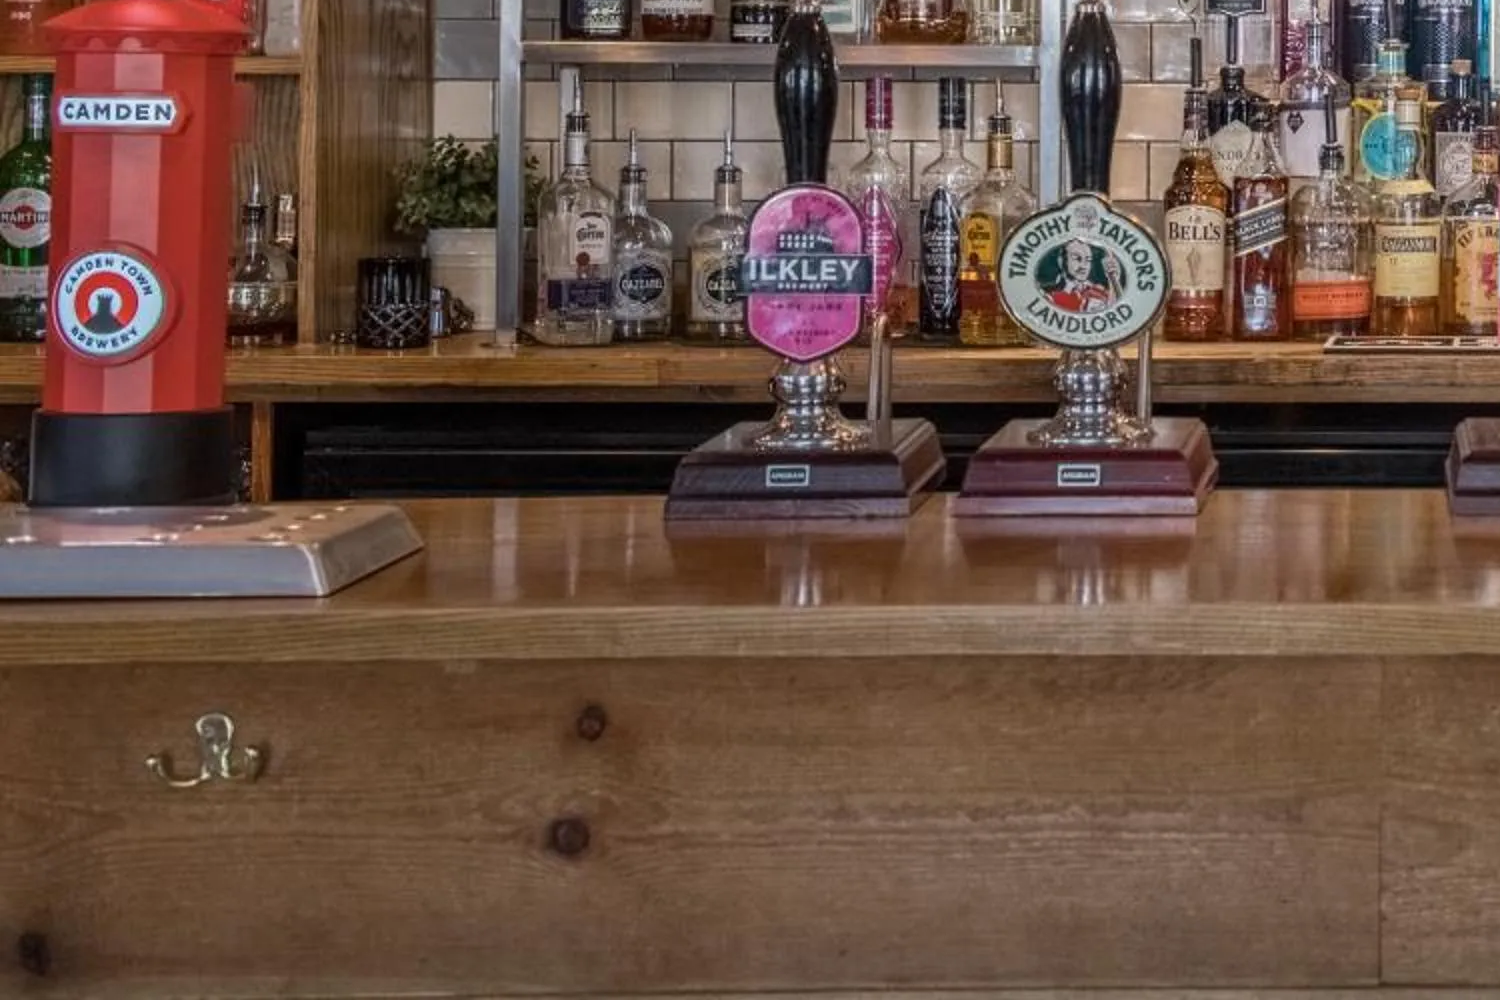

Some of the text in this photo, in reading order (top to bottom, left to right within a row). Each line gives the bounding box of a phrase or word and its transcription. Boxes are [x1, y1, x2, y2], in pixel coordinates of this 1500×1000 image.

[63, 102, 173, 121] CAMDEN
[1168, 220, 1222, 241] BELL'S
[1008, 214, 1072, 279] TIMOTHY
[1100, 217, 1156, 293] TAYLOR'S
[65, 257, 154, 297] CAMDEN TOWN
[750, 260, 859, 281] ILKLEY
[1026, 298, 1133, 335] LANDLORD
[70, 326, 139, 349] BREWERY
